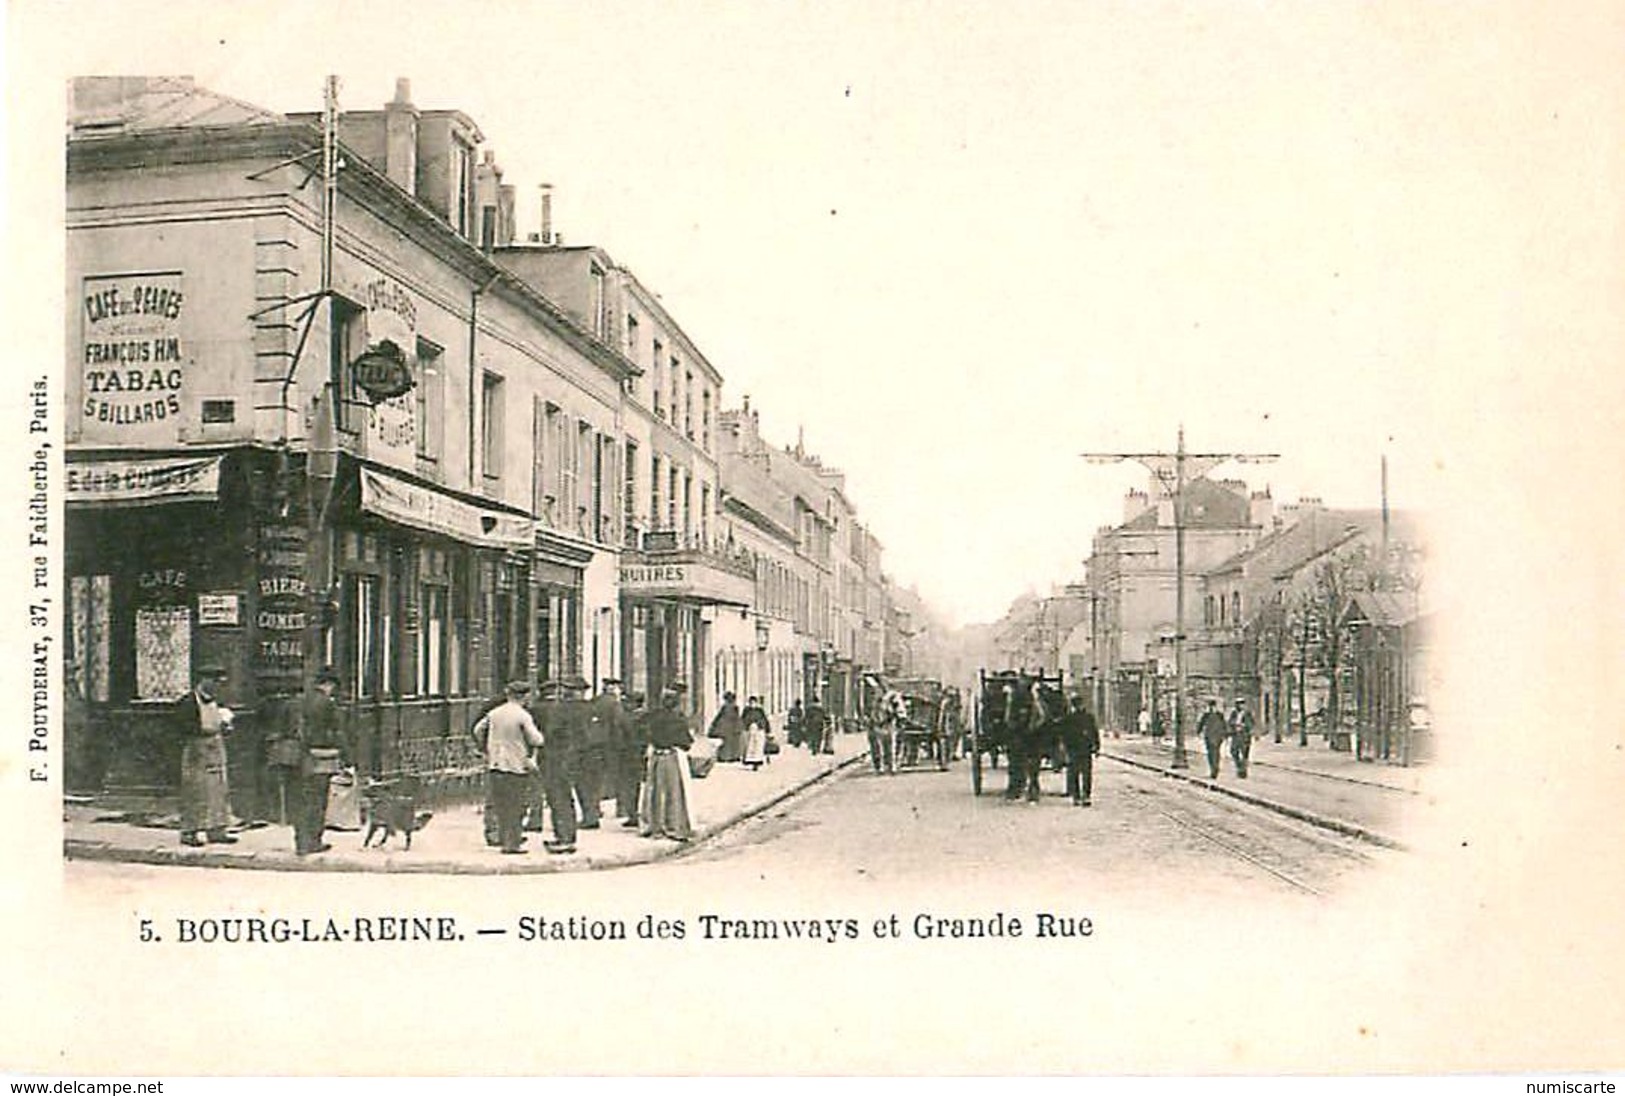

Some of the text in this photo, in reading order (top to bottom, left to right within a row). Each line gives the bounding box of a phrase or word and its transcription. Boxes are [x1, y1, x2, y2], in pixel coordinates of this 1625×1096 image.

[85, 341, 150, 366] FRANÇOIS
[86, 369, 182, 392] TABAC
[29, 374, 48, 434] Paris.
[98, 394, 181, 425] BILLARDS
[29, 440, 52, 548] Faidherbe,
[34, 556, 48, 588] rue
[30, 597, 52, 628] 37,
[30, 765, 48, 782] F.
[139, 919, 162, 943] 5.
[177, 917, 465, 943] BOURG-LA-REINE.
[518, 915, 627, 942] Station
[636, 914, 686, 940] des
[699, 914, 860, 944] Tramways
[872, 915, 900, 939] et
[913, 913, 1023, 940] Grande
[1035, 914, 1094, 938] Rue
